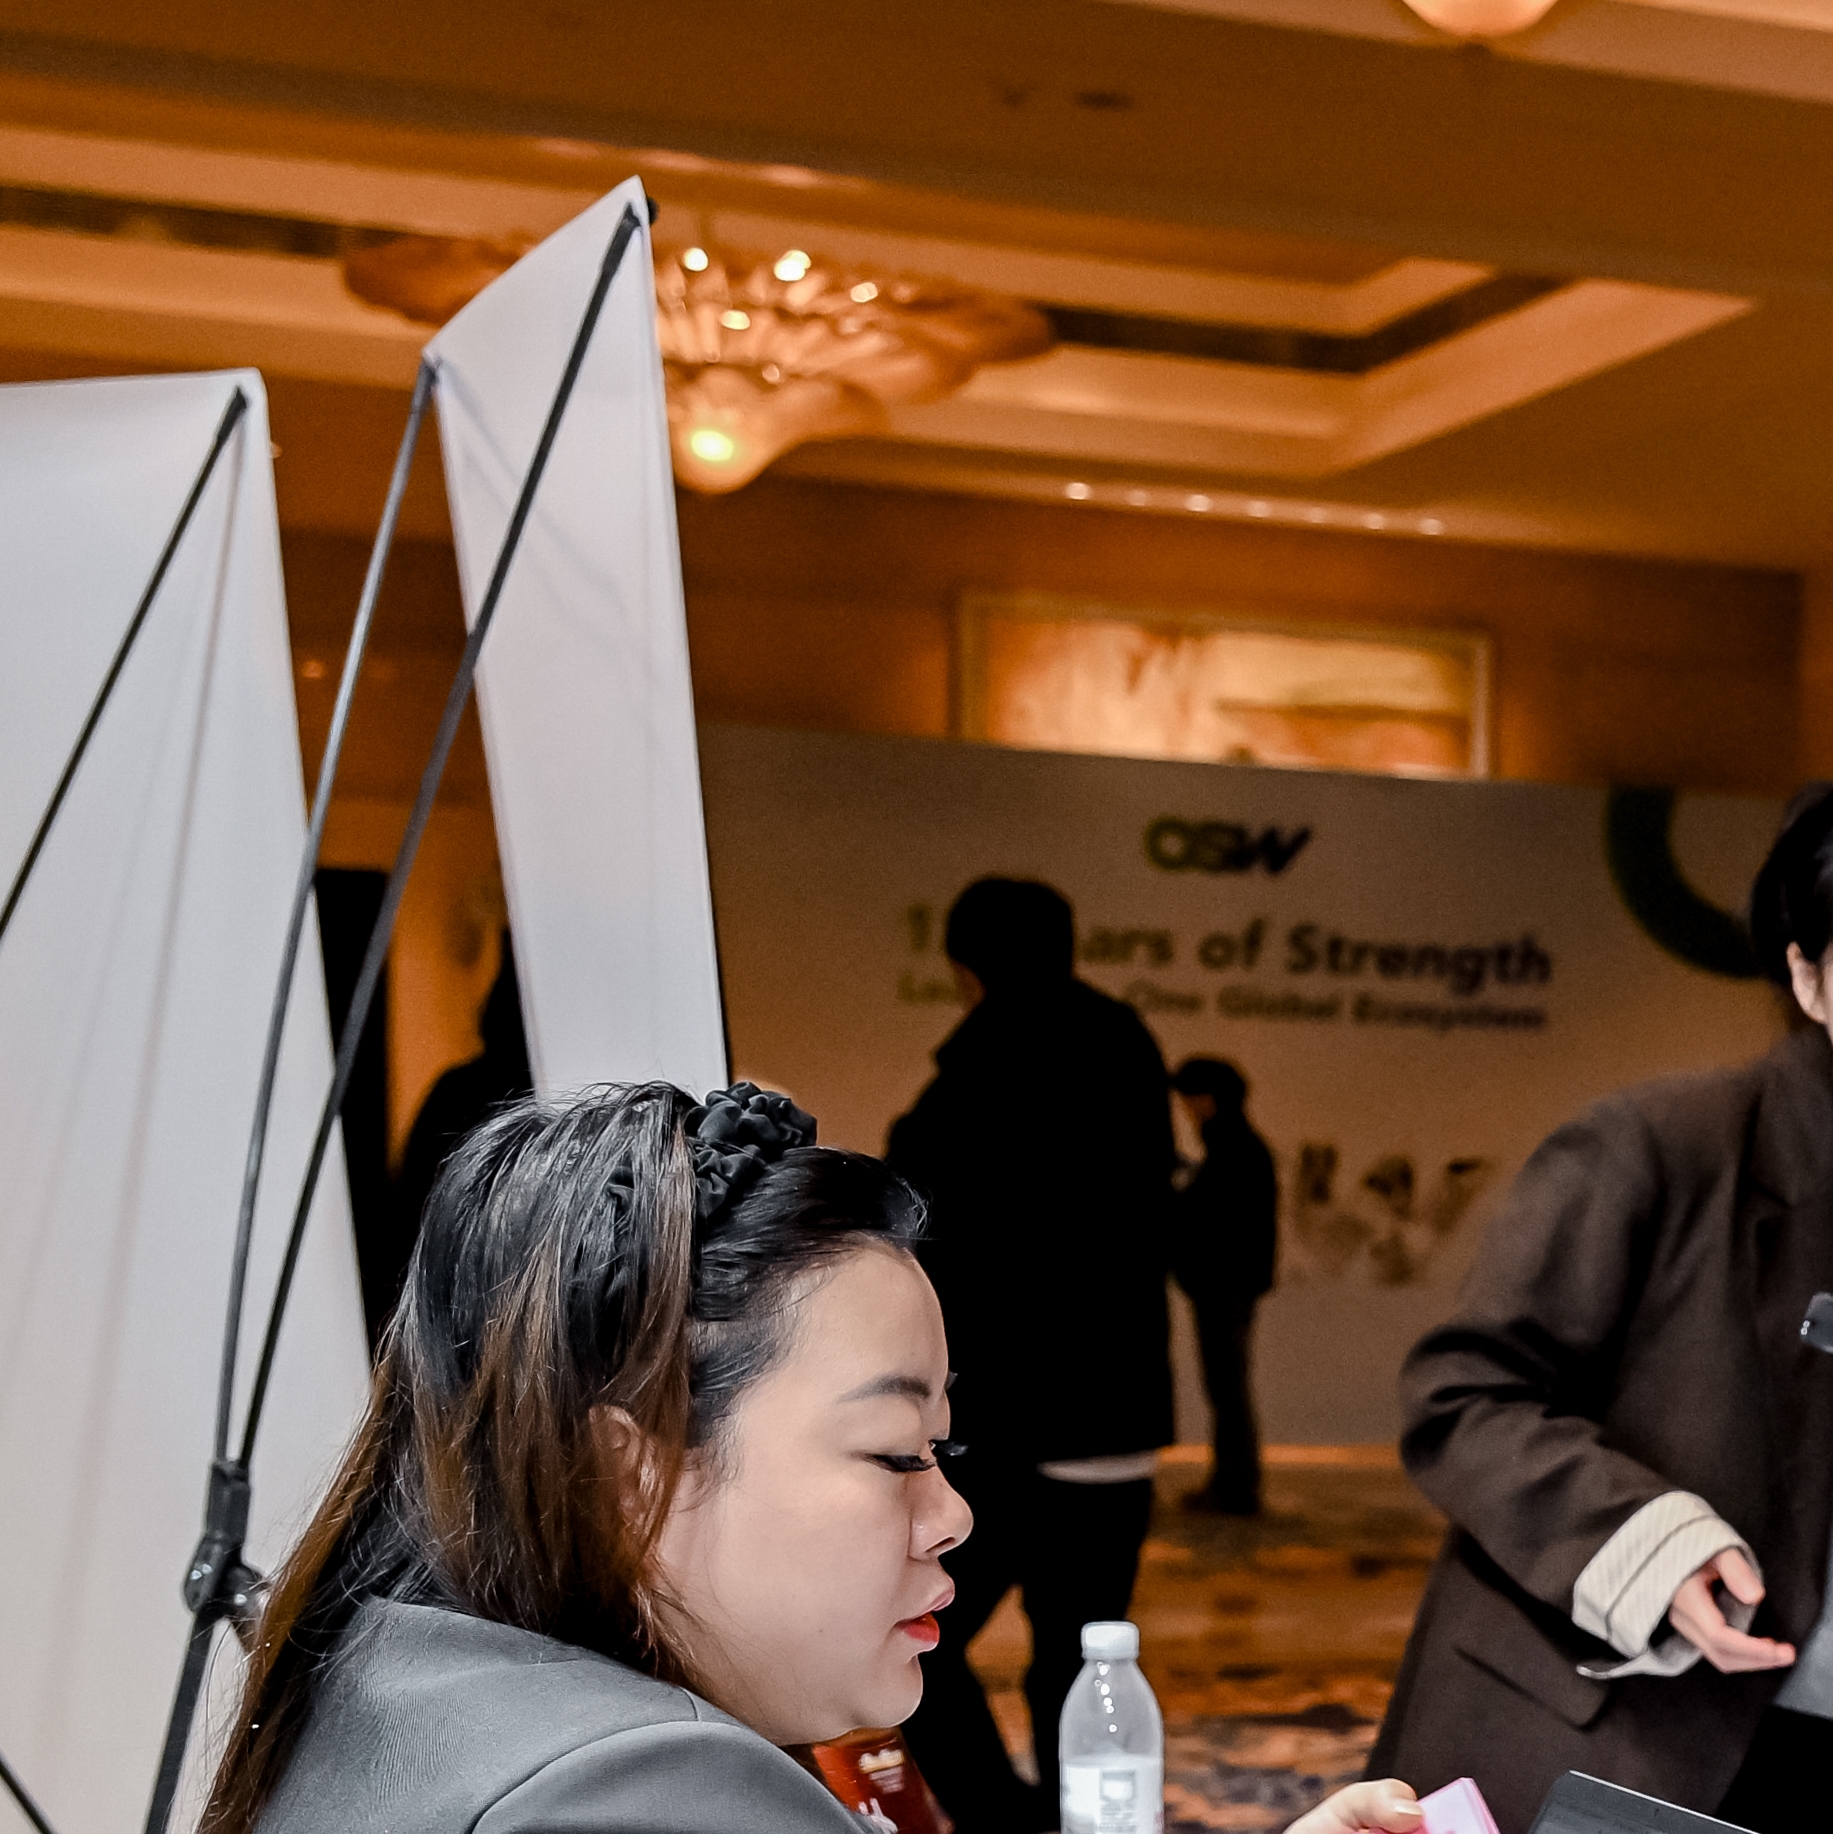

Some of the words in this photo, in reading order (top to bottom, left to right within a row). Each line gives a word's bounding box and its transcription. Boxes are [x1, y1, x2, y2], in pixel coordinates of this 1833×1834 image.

[1079, 924, 1175, 968] ars
[1198, 915, 1268, 971] of
[1285, 922, 1553, 997] Strength
